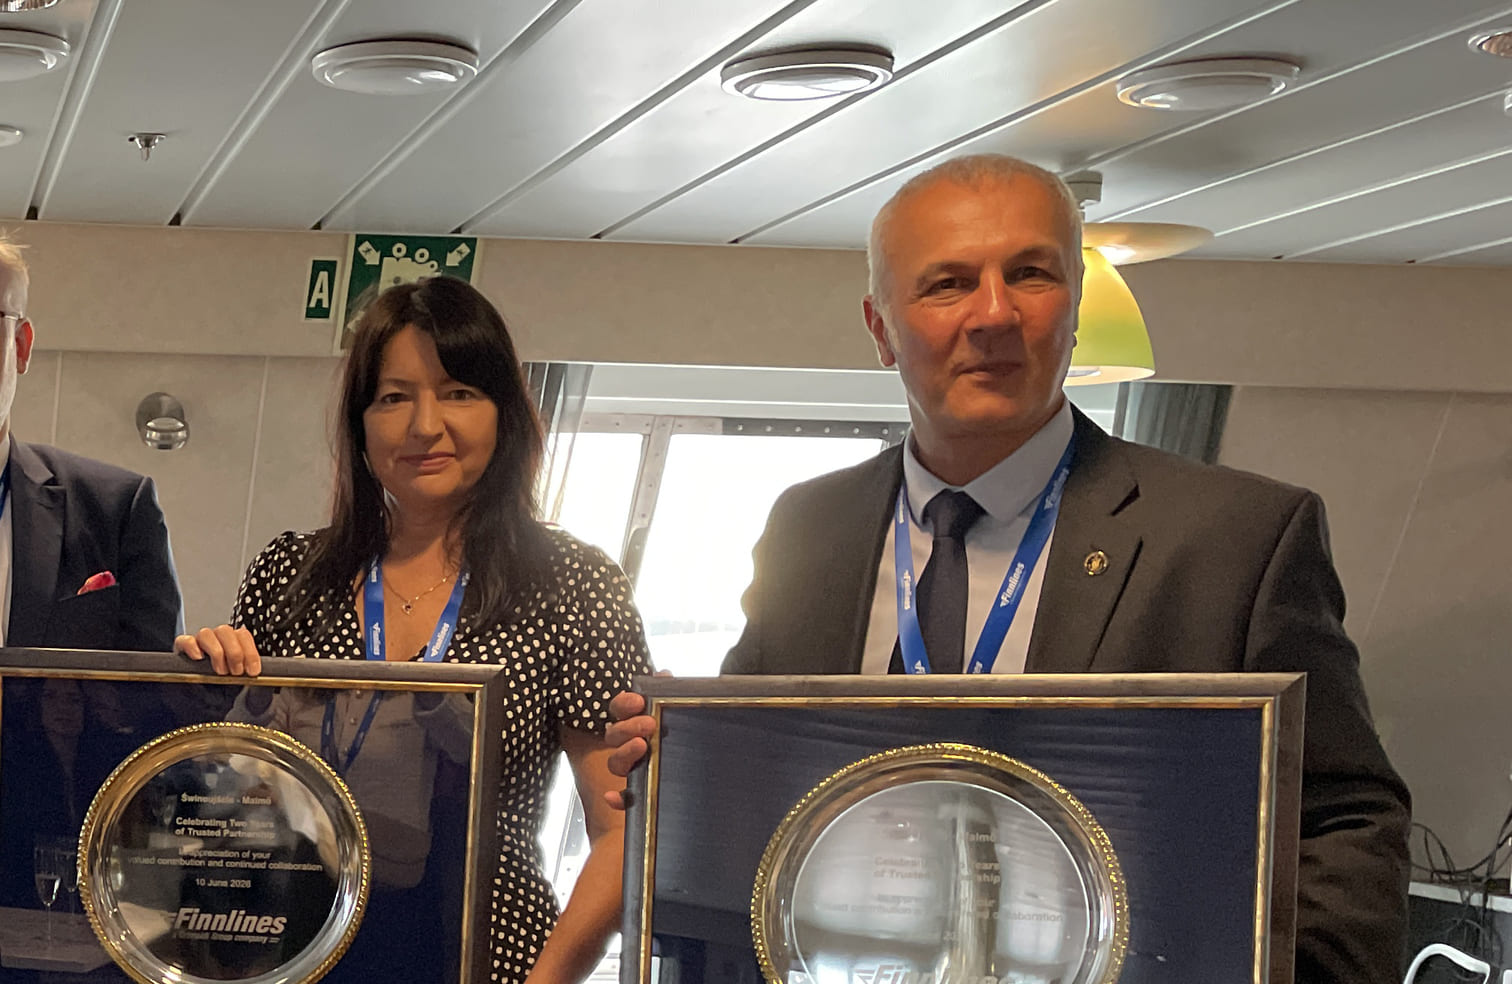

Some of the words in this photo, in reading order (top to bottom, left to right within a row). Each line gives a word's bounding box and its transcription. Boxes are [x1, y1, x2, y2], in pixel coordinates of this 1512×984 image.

[309, 271, 329, 308] A
[1001, 562, 1025, 603] Finnlines
[175, 816, 228, 829] Celebrating
[229, 819, 248, 828] Two
[175, 827, 186, 835] of
[187, 827, 221, 837] Trusted
[223, 828, 276, 840] Partnership
[241, 850, 251, 858] of
[252, 851, 272, 860] your
[157, 857, 206, 868] contribution
[207, 859, 224, 868] and
[225, 860, 267, 869] continued
[268, 861, 323, 872] collaboration
[196, 878, 206, 887] 10
[207, 879, 228, 888] June
[174, 907, 287, 935] Finnlines
